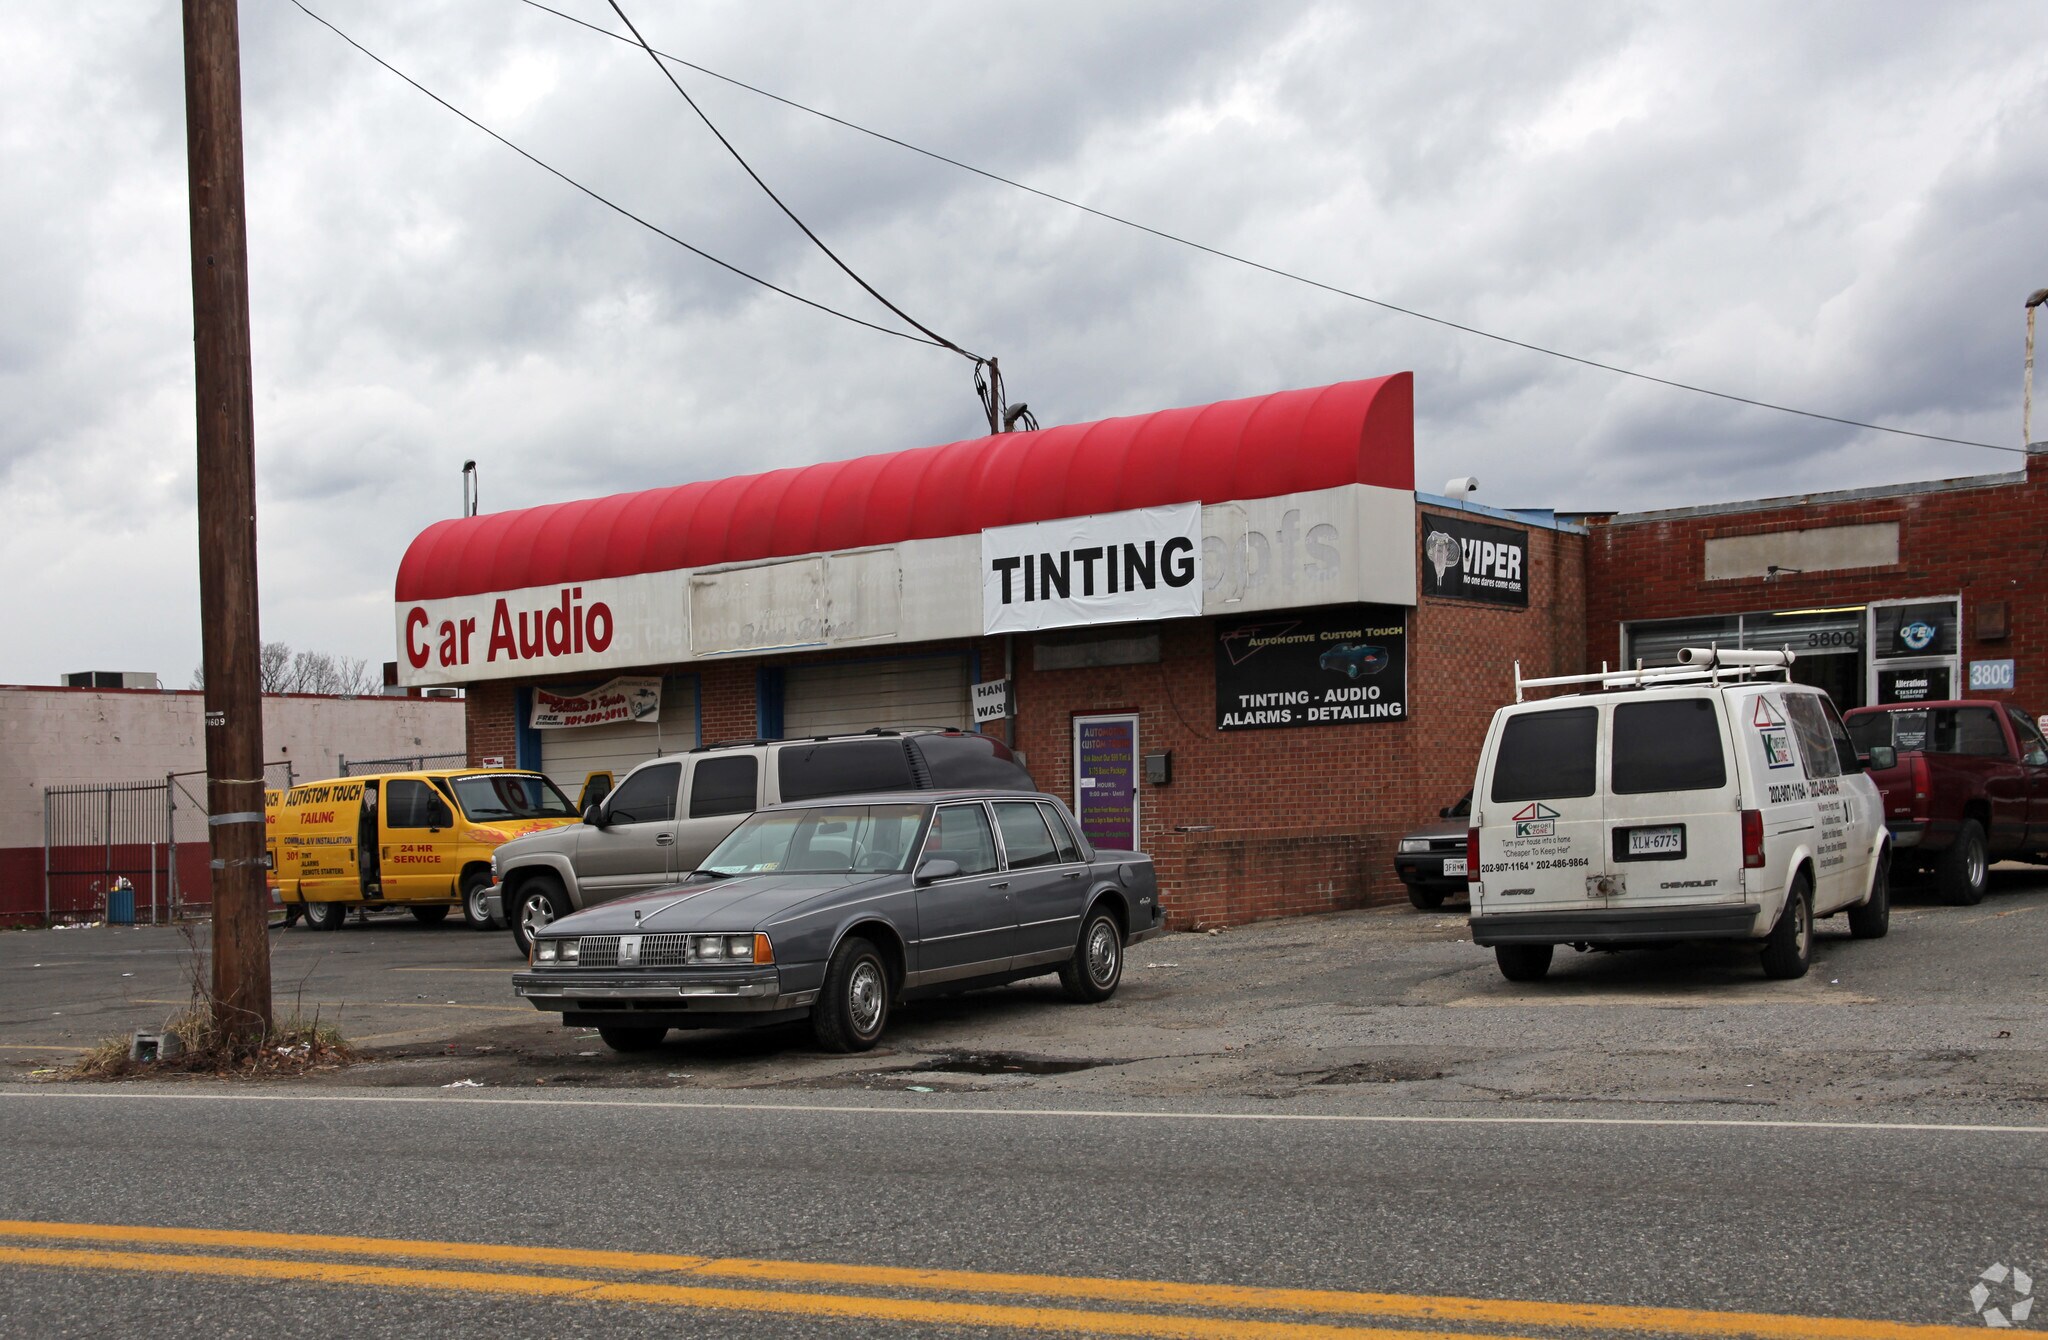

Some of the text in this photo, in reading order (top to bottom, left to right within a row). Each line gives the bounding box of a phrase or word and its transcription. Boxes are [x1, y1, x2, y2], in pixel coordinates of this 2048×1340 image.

[1461, 537, 1522, 580] VIPER
[992, 536, 1195, 605] TINTING
[1463, 574, 1522, 590] No one dares come close.
[406, 606, 476, 669] Car
[487, 587, 614, 662] Audio
[1900, 626, 1935, 638] OPEN
[1248, 627, 1403, 647] AUTOMOTIVE CUSTOM TOUCH
[1808, 631, 1855, 648] 3800
[1971, 664, 2010, 686] 3800
[977, 683, 1006, 697] HAN
[1895, 679, 1928, 688] Alterations
[1239, 690, 1309, 708] TINTING
[1324, 686, 1380, 702] AUDIO
[977, 703, 1006, 717] WAS
[1222, 709, 1291, 726] ALARMS
[1308, 702, 1402, 721] DETAILING
[1776, 750, 1789, 762] ZONE
[332, 785, 362, 802] TOUCH
[1769, 783, 1806, 803] 202-907-1164
[300, 811, 334, 824] TAILING
[315, 836, 352, 844] INSTALLATION
[1632, 834, 1679, 849] XLW-6775
[286, 852, 299, 860] 301
[1504, 849, 1531, 858] "Cheaper
[1540, 847, 1556, 856] Keep
[1481, 858, 1589, 873] 202-907-1164 202-486-9864
[1660, 880, 1718, 889] CHEVROLET
